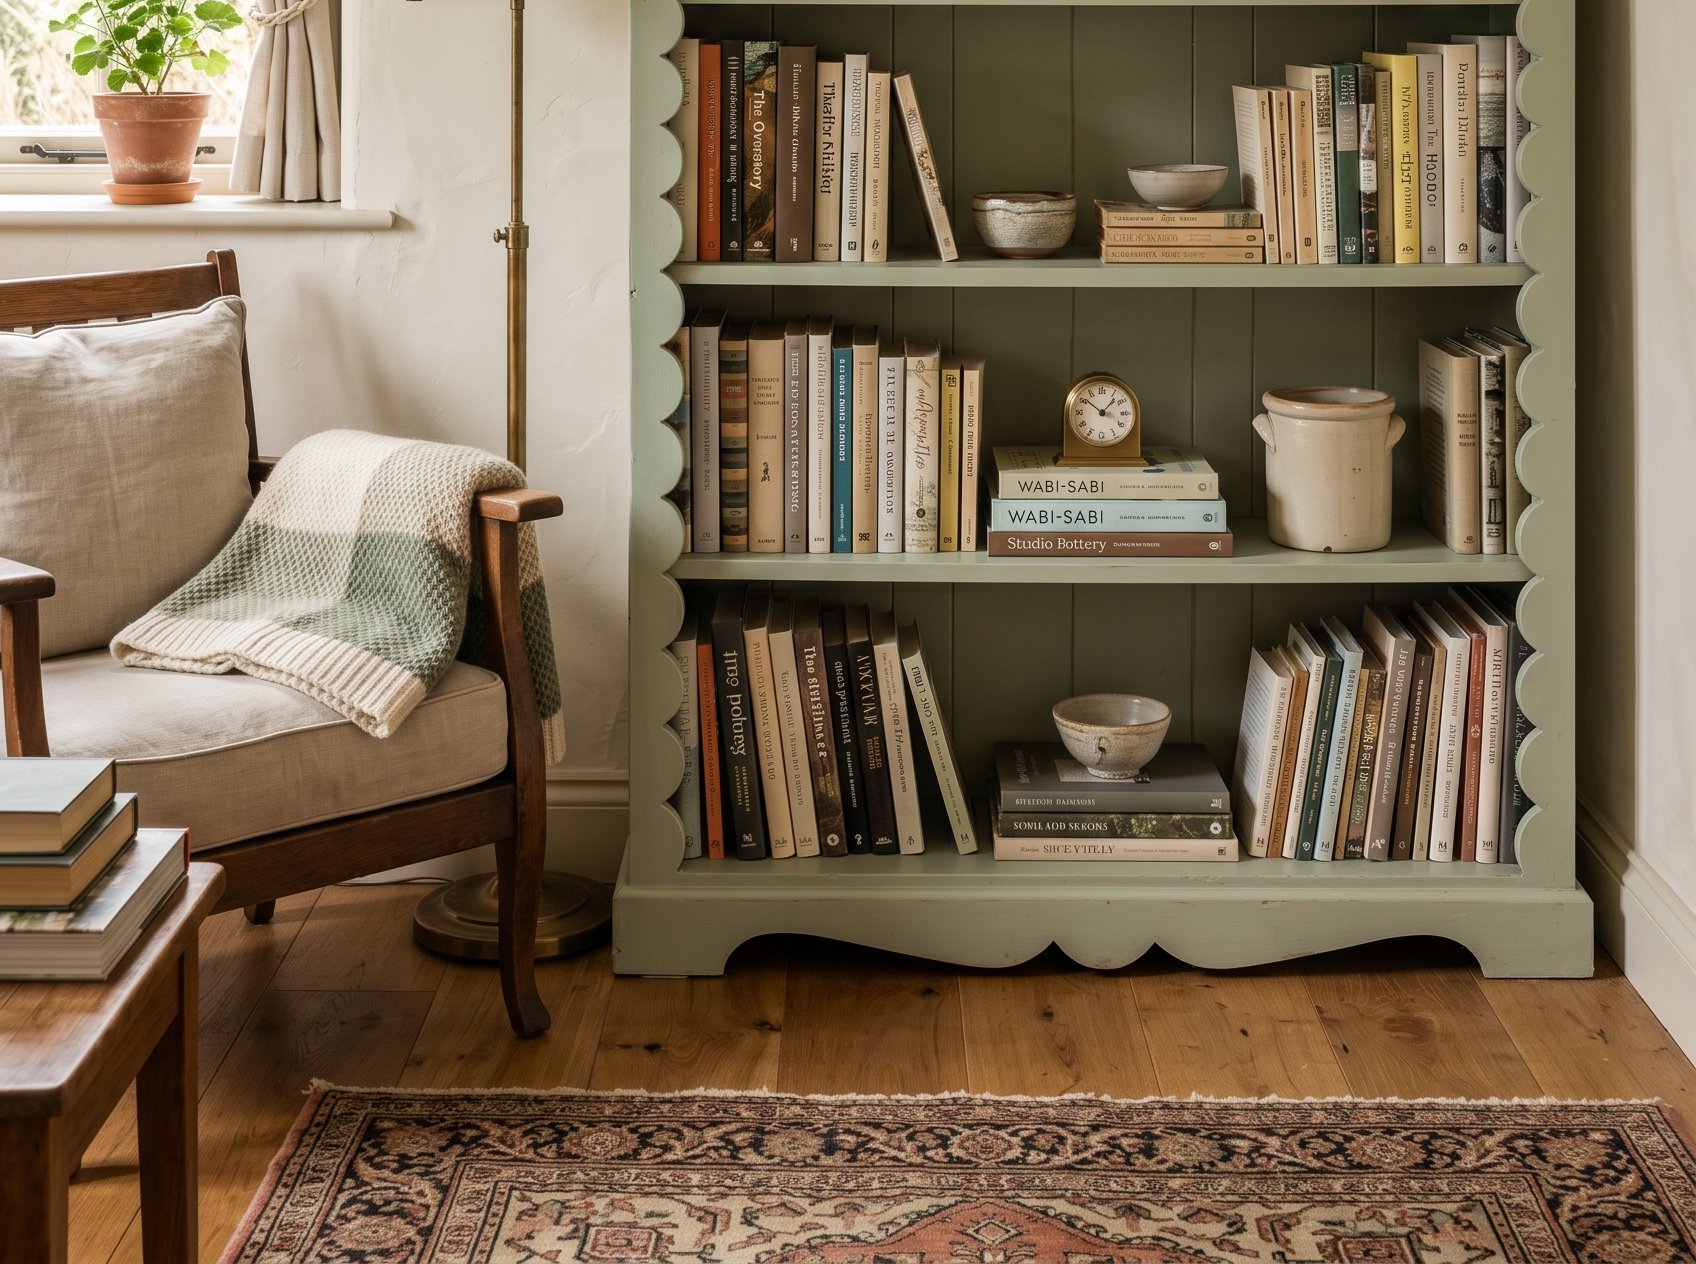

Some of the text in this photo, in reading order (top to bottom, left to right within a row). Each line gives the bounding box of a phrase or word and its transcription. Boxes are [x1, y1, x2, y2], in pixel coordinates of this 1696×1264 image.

[1017, 480, 1105, 493] WABI-SABI
[1008, 509, 1104, 524] WABI-SABI
[1007, 537, 1107, 553] Studio Bottery
